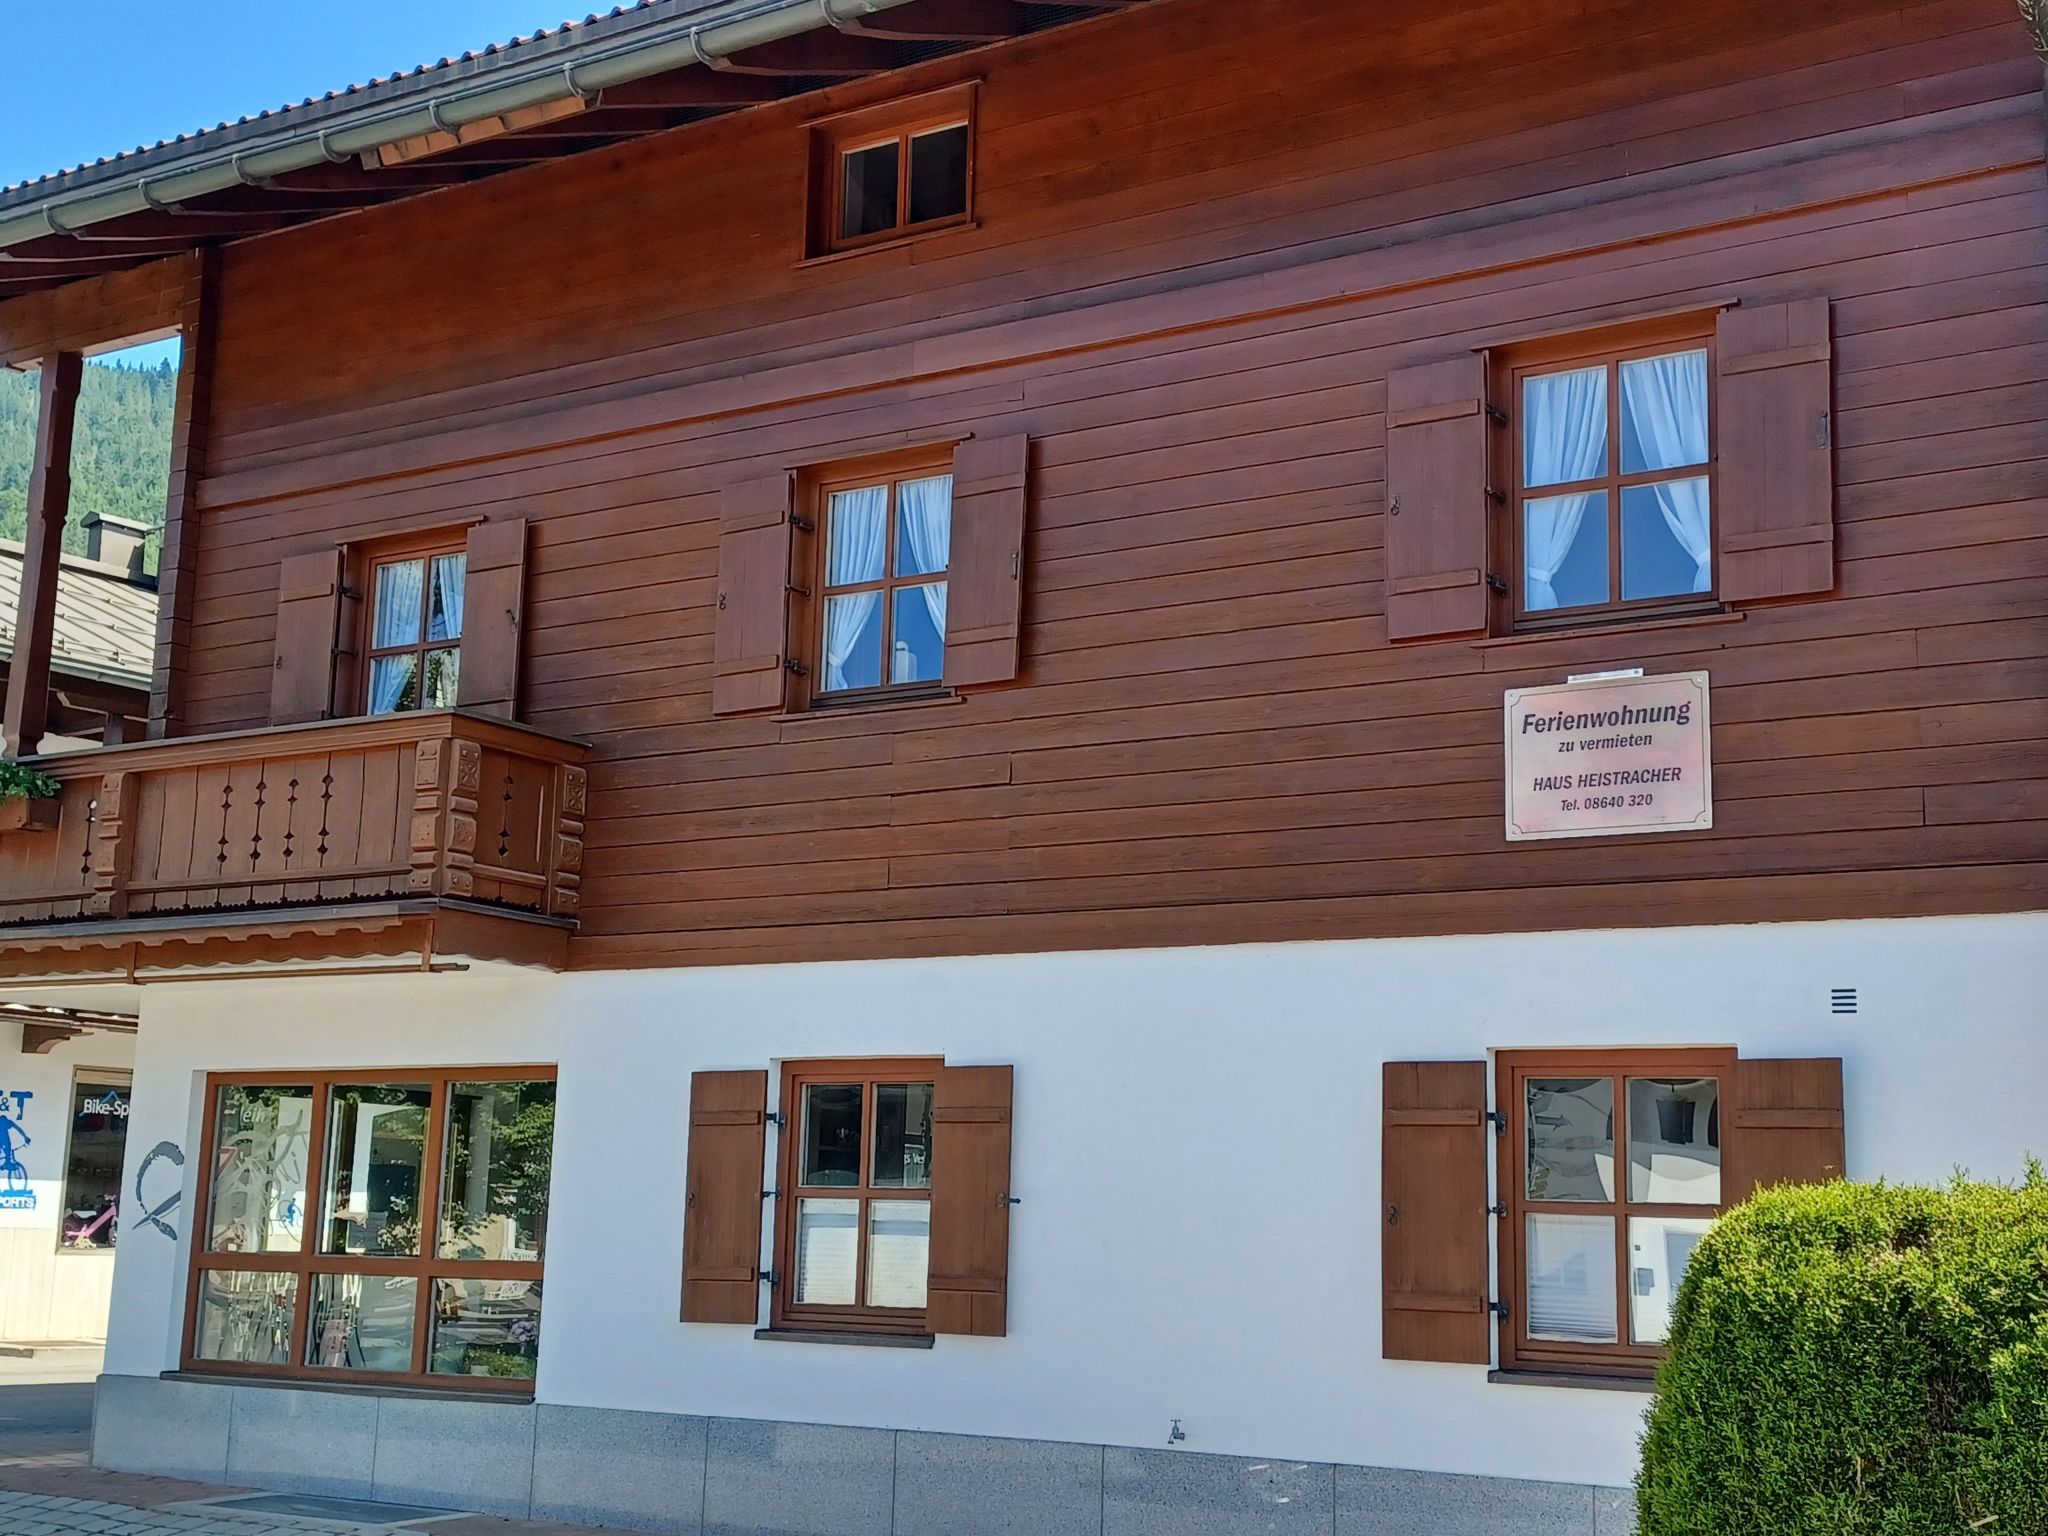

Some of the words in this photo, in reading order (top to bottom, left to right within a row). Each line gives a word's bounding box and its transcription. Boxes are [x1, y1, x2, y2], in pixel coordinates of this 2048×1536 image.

[1522, 701, 1692, 734] Ferienwohnung
[1558, 740, 1574, 753] zu
[1580, 733, 1652, 751] vermieten
[1533, 775, 1573, 792] HAUS
[1578, 767, 1682, 788] HEISTRACHER
[1561, 799, 1580, 811] Tel.
[1584, 795, 1624, 810] 08640
[1628, 793, 1653, 807] 320
